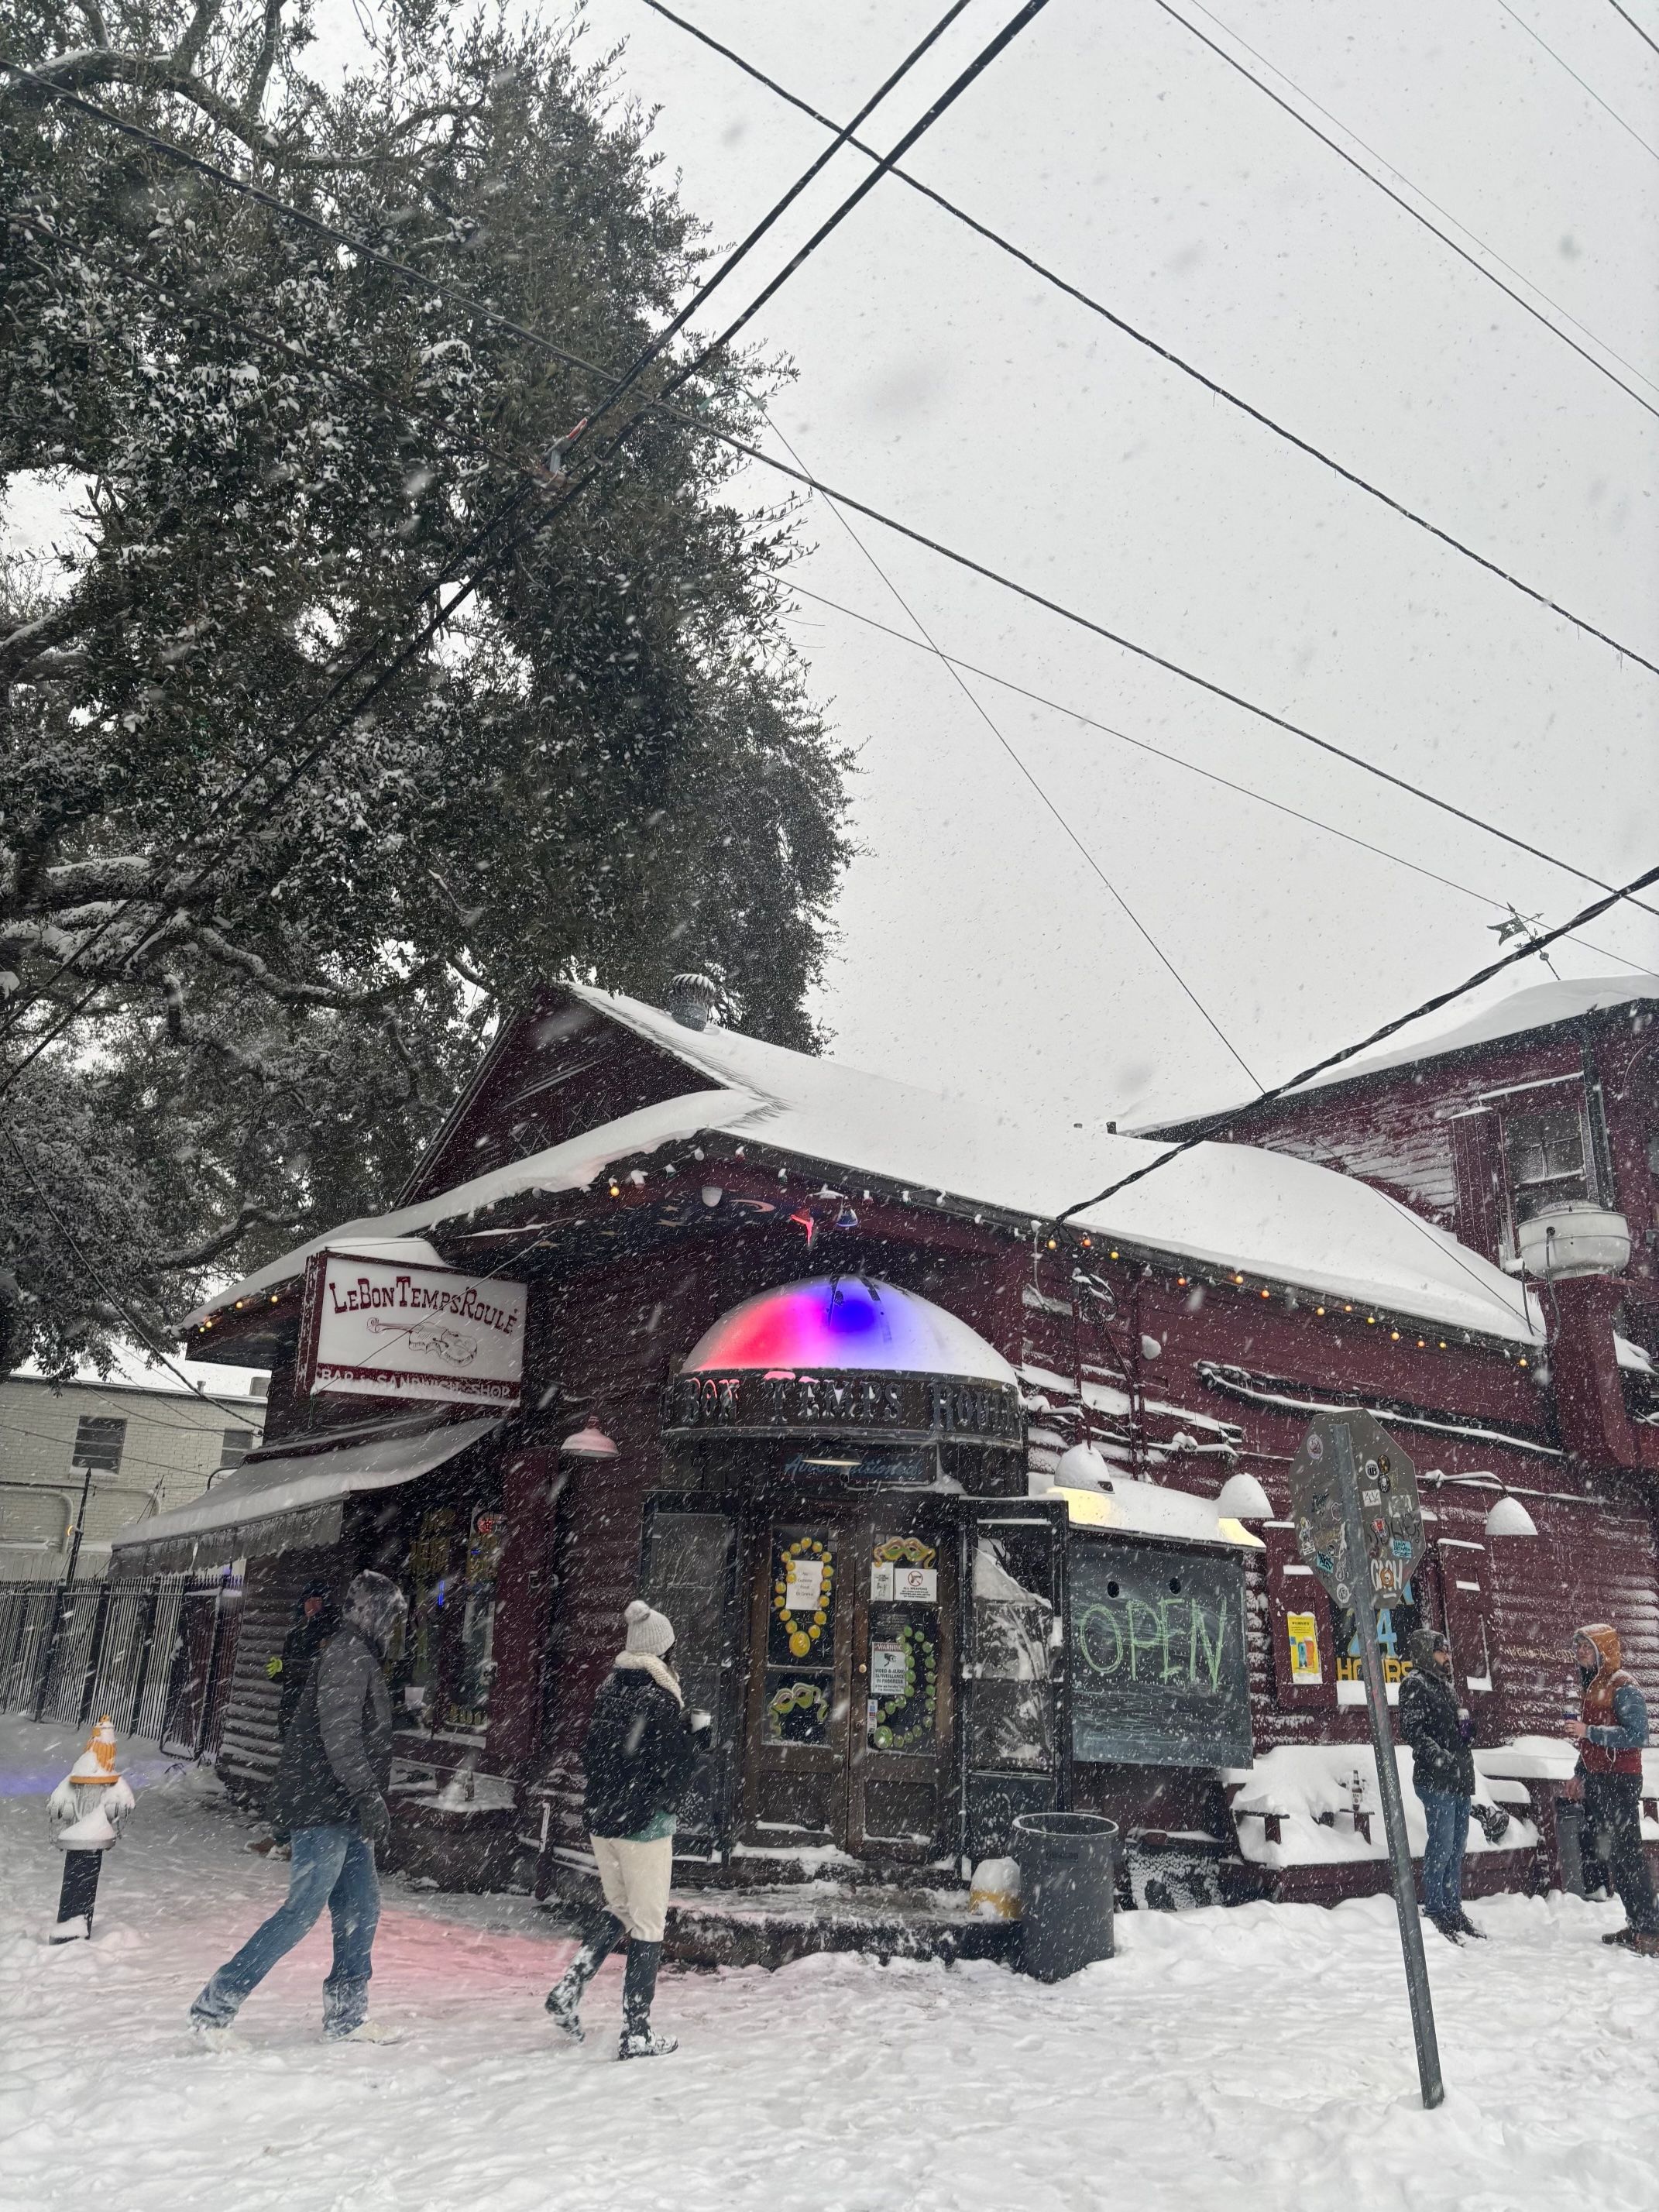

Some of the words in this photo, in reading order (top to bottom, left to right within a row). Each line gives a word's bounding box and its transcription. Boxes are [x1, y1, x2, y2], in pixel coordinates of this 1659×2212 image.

[471, 1382, 510, 1400] SHOP
[764, 1376, 903, 1425] TEMPS
[1080, 1593, 1228, 1693] OPEN
